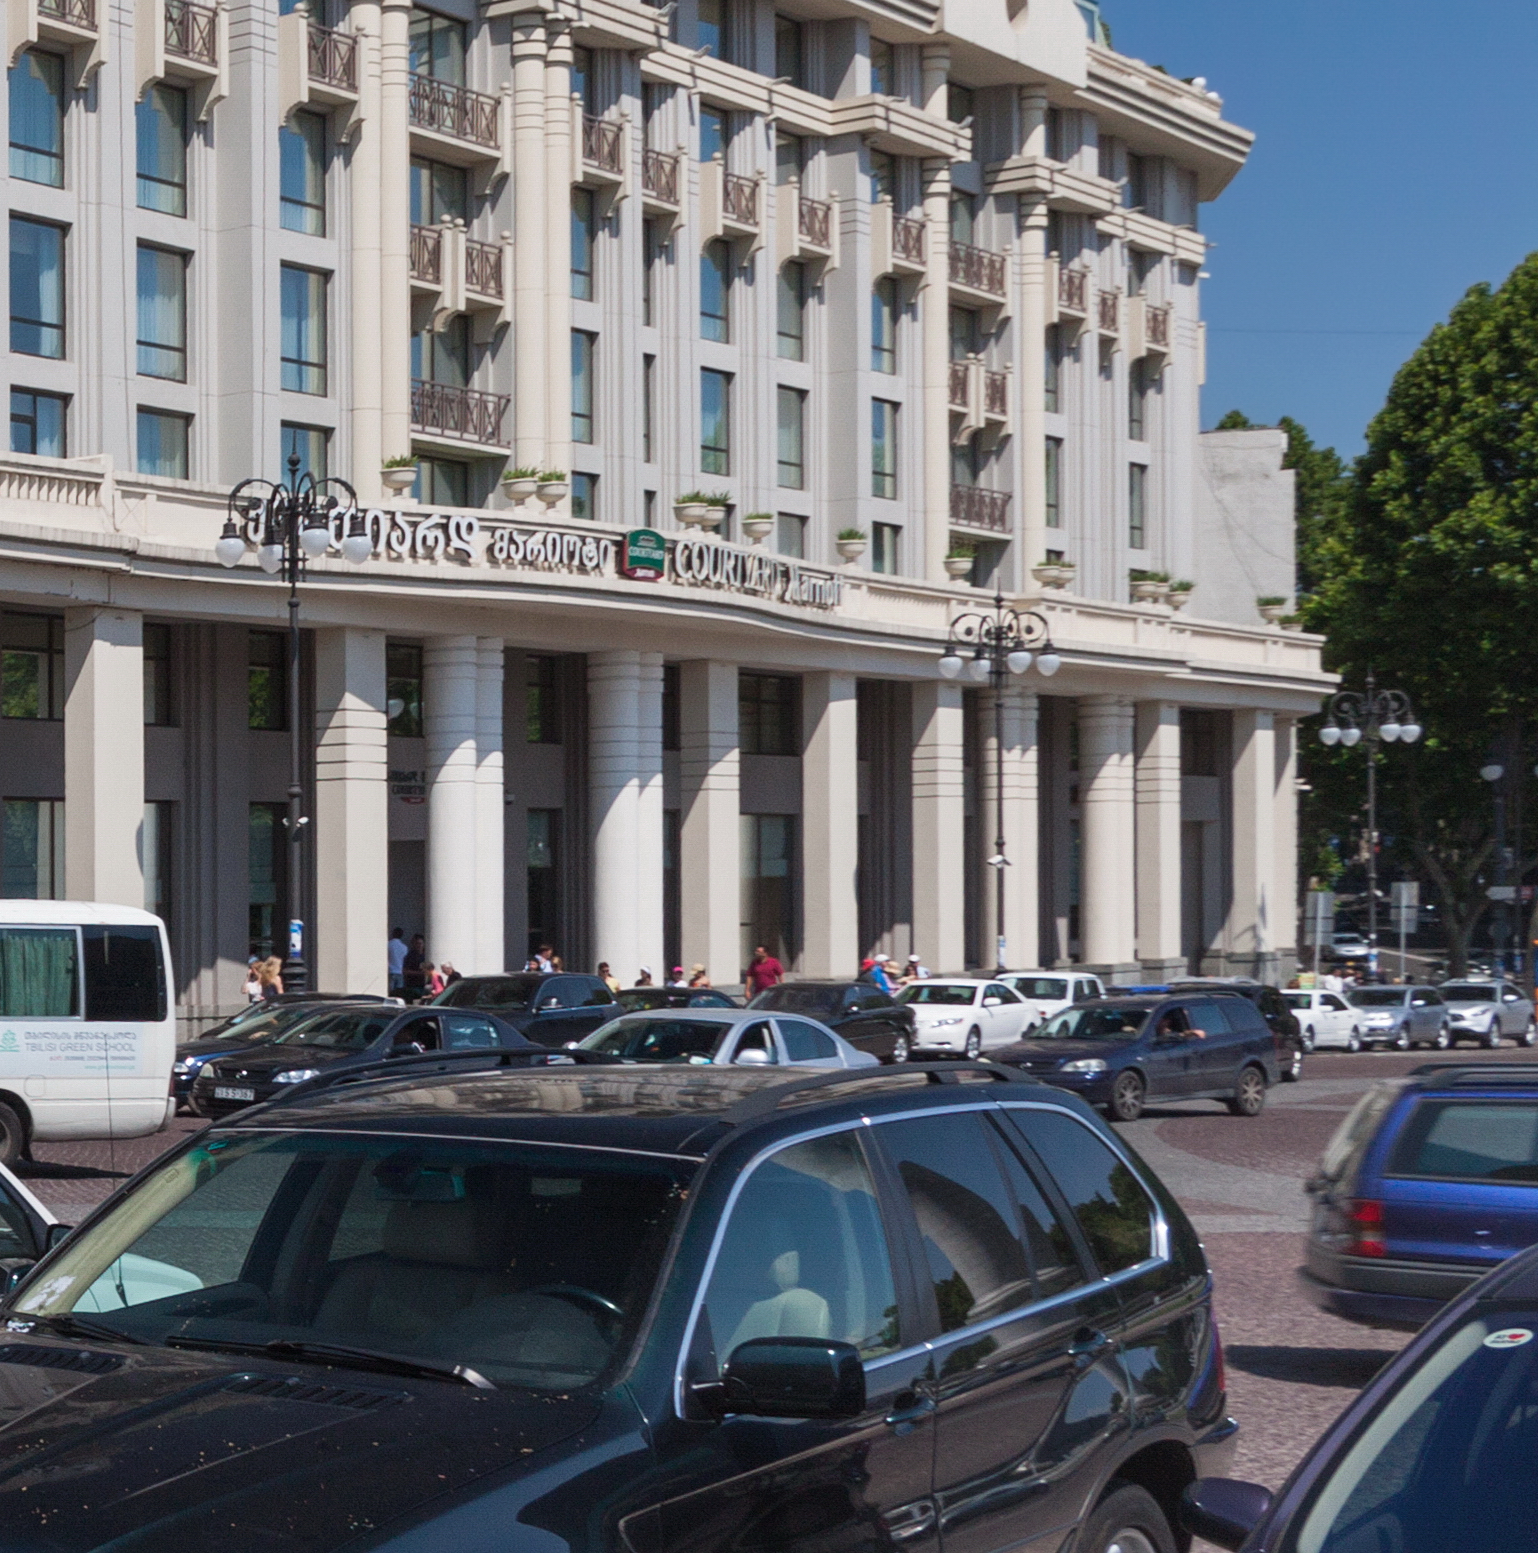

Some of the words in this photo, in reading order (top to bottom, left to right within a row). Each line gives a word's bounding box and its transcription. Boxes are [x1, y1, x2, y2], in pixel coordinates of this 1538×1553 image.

[493, 529, 612, 569] მარიოტი
[674, 540, 782, 595] COURTYARD
[25, 1043, 57, 1052] TBILISI
[59, 1043, 94, 1052] GREEN
[95, 1043, 136, 1052] SCHOOL
